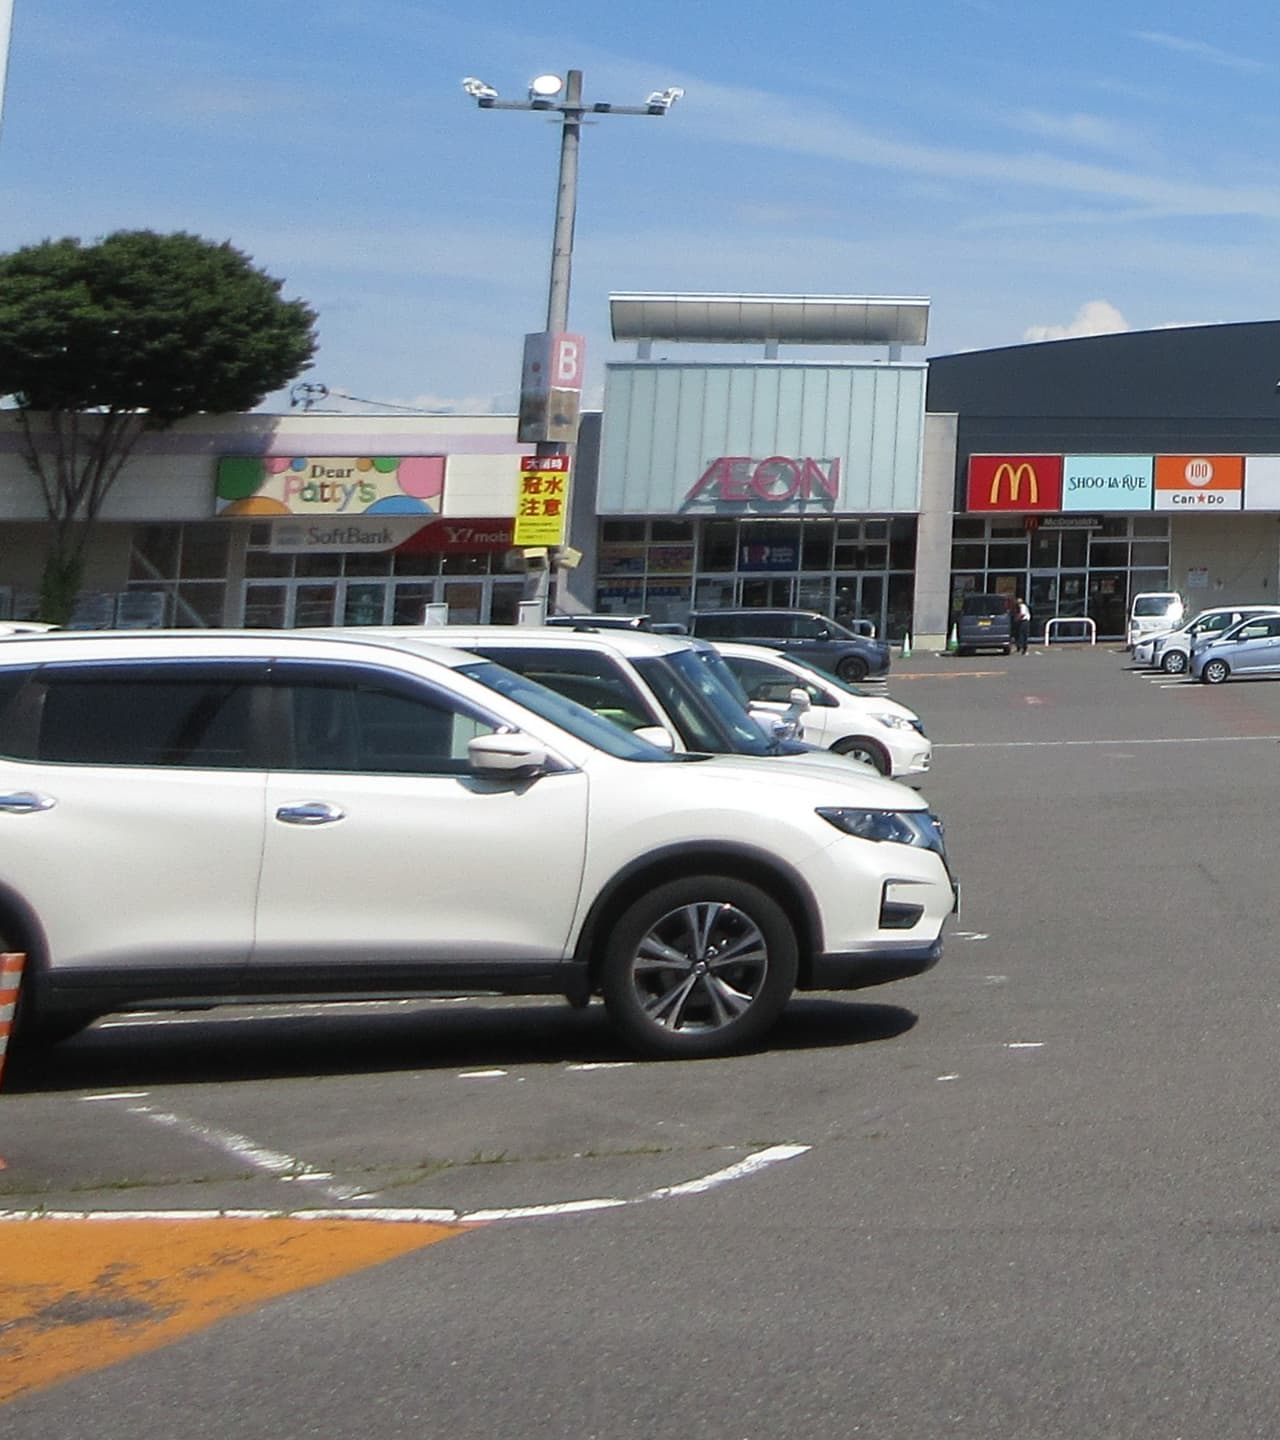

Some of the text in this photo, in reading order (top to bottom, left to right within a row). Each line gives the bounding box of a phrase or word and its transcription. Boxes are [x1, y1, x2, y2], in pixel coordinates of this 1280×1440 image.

[558, 341, 577, 380] B
[310, 464, 355, 479] Dear
[1190, 459, 1209, 478] 100
[284, 475, 377, 511] Patty's
[522, 476, 563, 495] 冠水
[519, 498, 562, 517] 注意
[1172, 493, 1225, 504] Can Do
[307, 525, 394, 545] SoftBank
